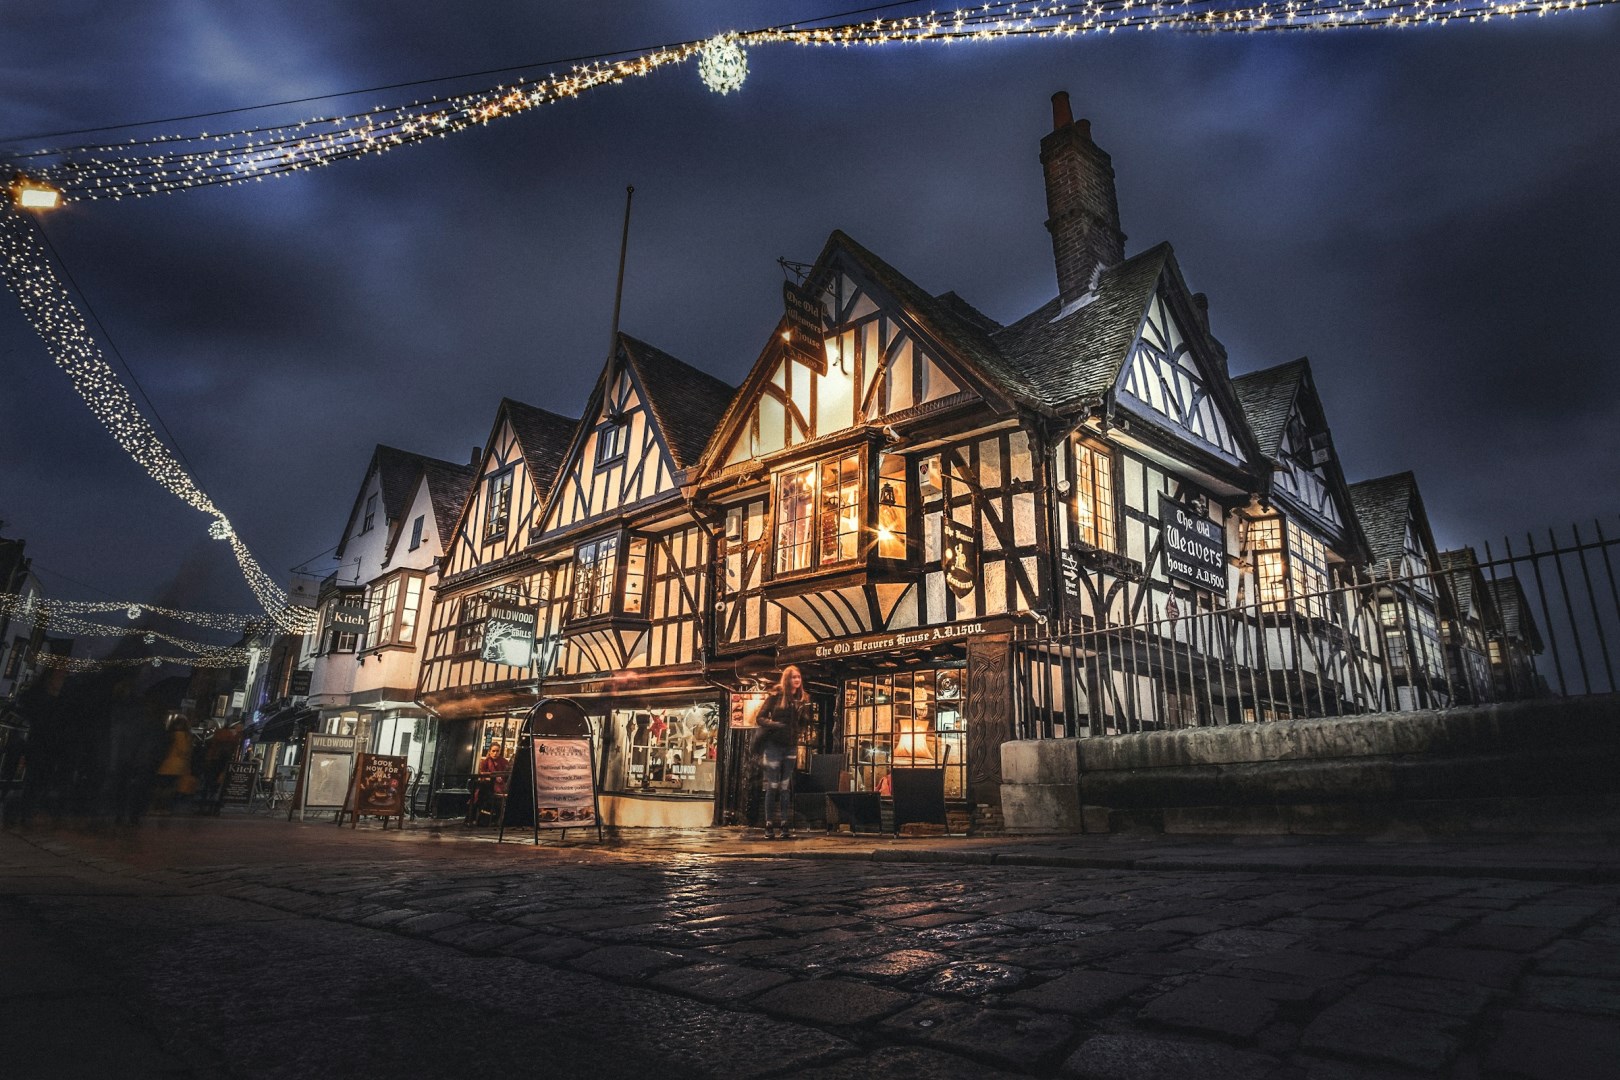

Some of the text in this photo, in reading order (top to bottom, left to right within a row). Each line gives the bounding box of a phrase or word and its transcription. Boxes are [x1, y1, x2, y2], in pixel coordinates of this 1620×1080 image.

[1177, 509, 1210, 538] The Old
[334, 611, 365, 626] Kitch
[491, 607, 534, 624] WILDWOOD
[815, 646, 832, 658] The
[833, 643, 850, 654] Old
[853, 638, 895, 651] Weavers
[896, 632, 930, 647] House
[313, 737, 354, 748] WILDWOOD
[228, 763, 256, 774] Kitch
[373, 759, 393, 767] BOOK
